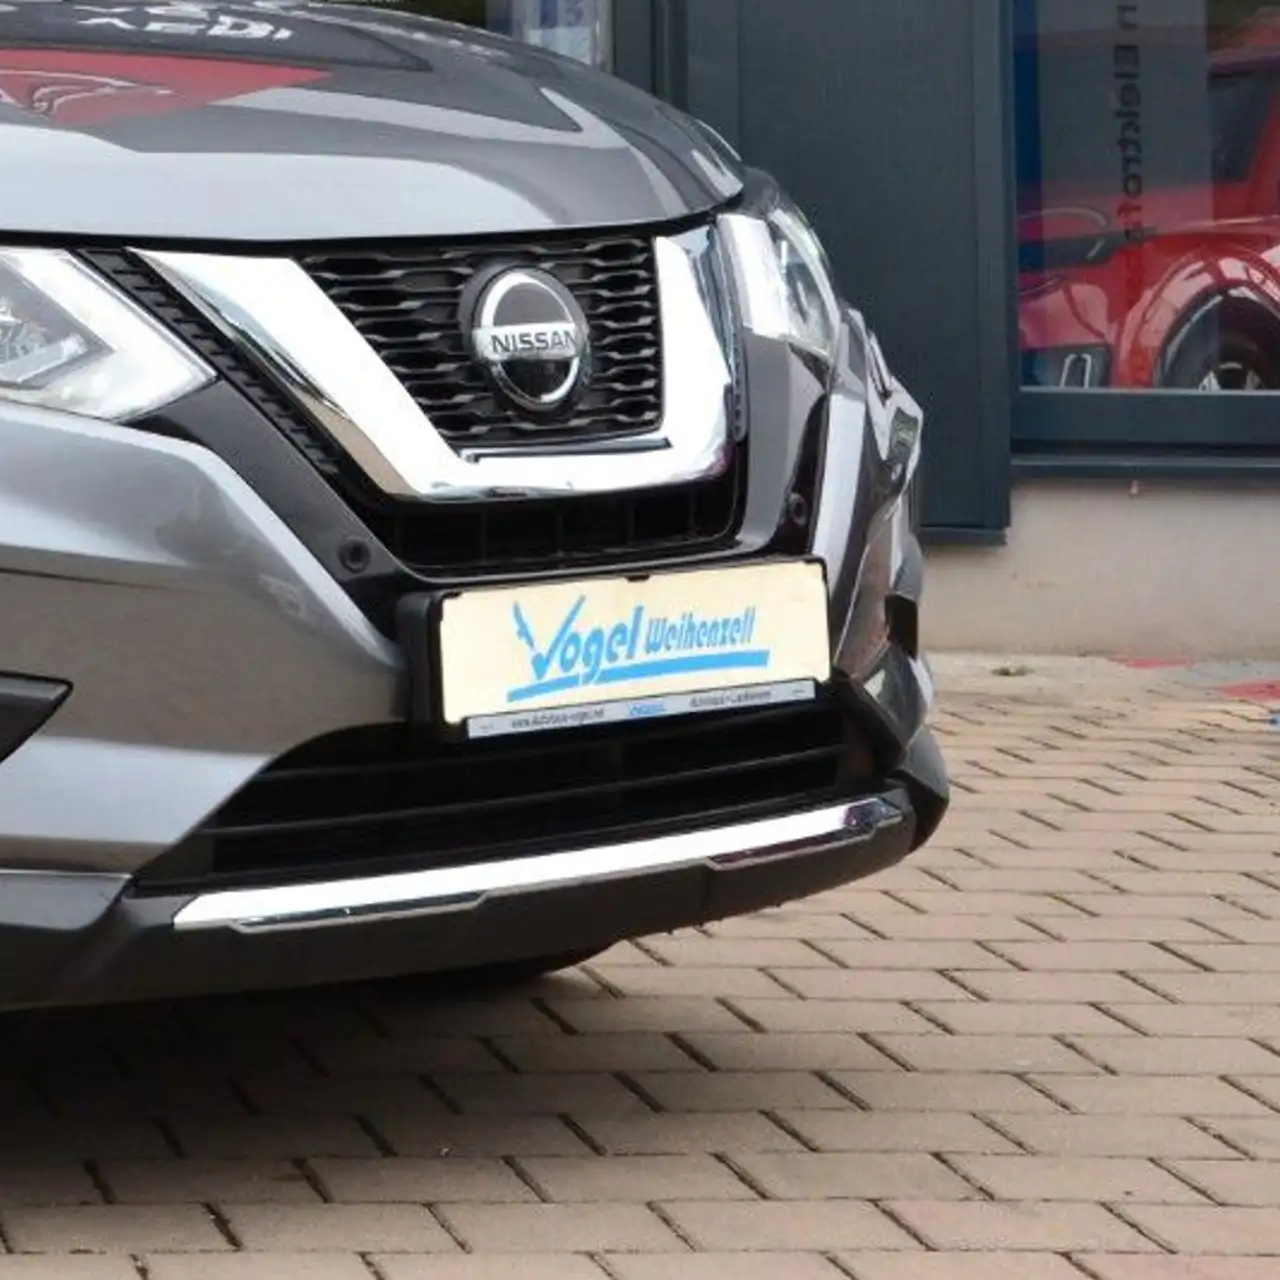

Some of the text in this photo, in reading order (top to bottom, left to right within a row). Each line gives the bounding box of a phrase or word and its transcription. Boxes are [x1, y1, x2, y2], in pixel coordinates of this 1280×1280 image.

[491, 330, 578, 353] NISSAN
[513, 595, 756, 683] Vogel Weihenzell
